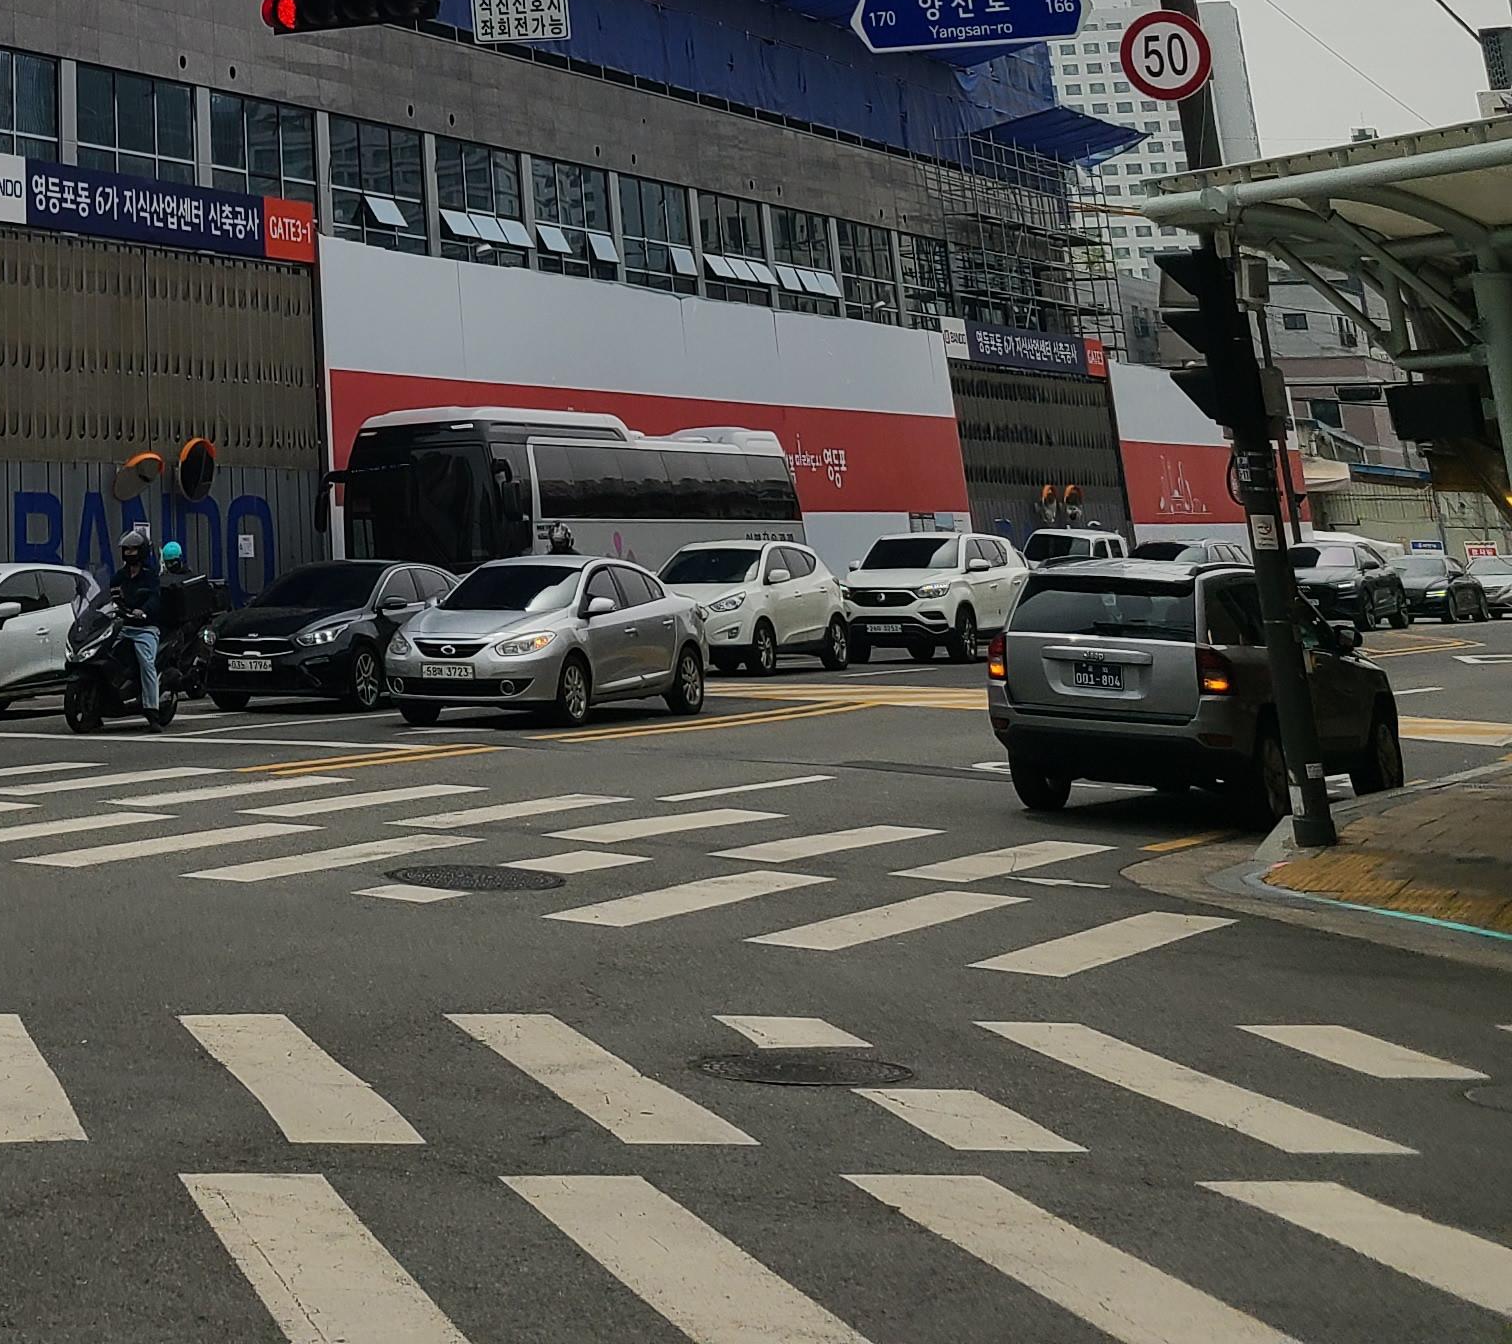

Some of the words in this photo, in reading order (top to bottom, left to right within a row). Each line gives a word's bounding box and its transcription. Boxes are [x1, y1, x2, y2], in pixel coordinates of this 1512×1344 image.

[481, 15, 563, 38] 좌회전가능
[870, 11, 896, 28] 170
[929, 21, 1013, 40] Yangsan-ro
[1143, 33, 1188, 78] 50
[31, 174, 91, 218] 영등포동
[95, 186, 119, 221] 6가
[123, 188, 204, 233] 지식산업센터
[208, 202, 260, 240] 신축공사
[269, 215, 312, 244] GATE3-1
[823, 448, 847, 489] 영등포
[1076, 672, 1121, 687] 001-804
